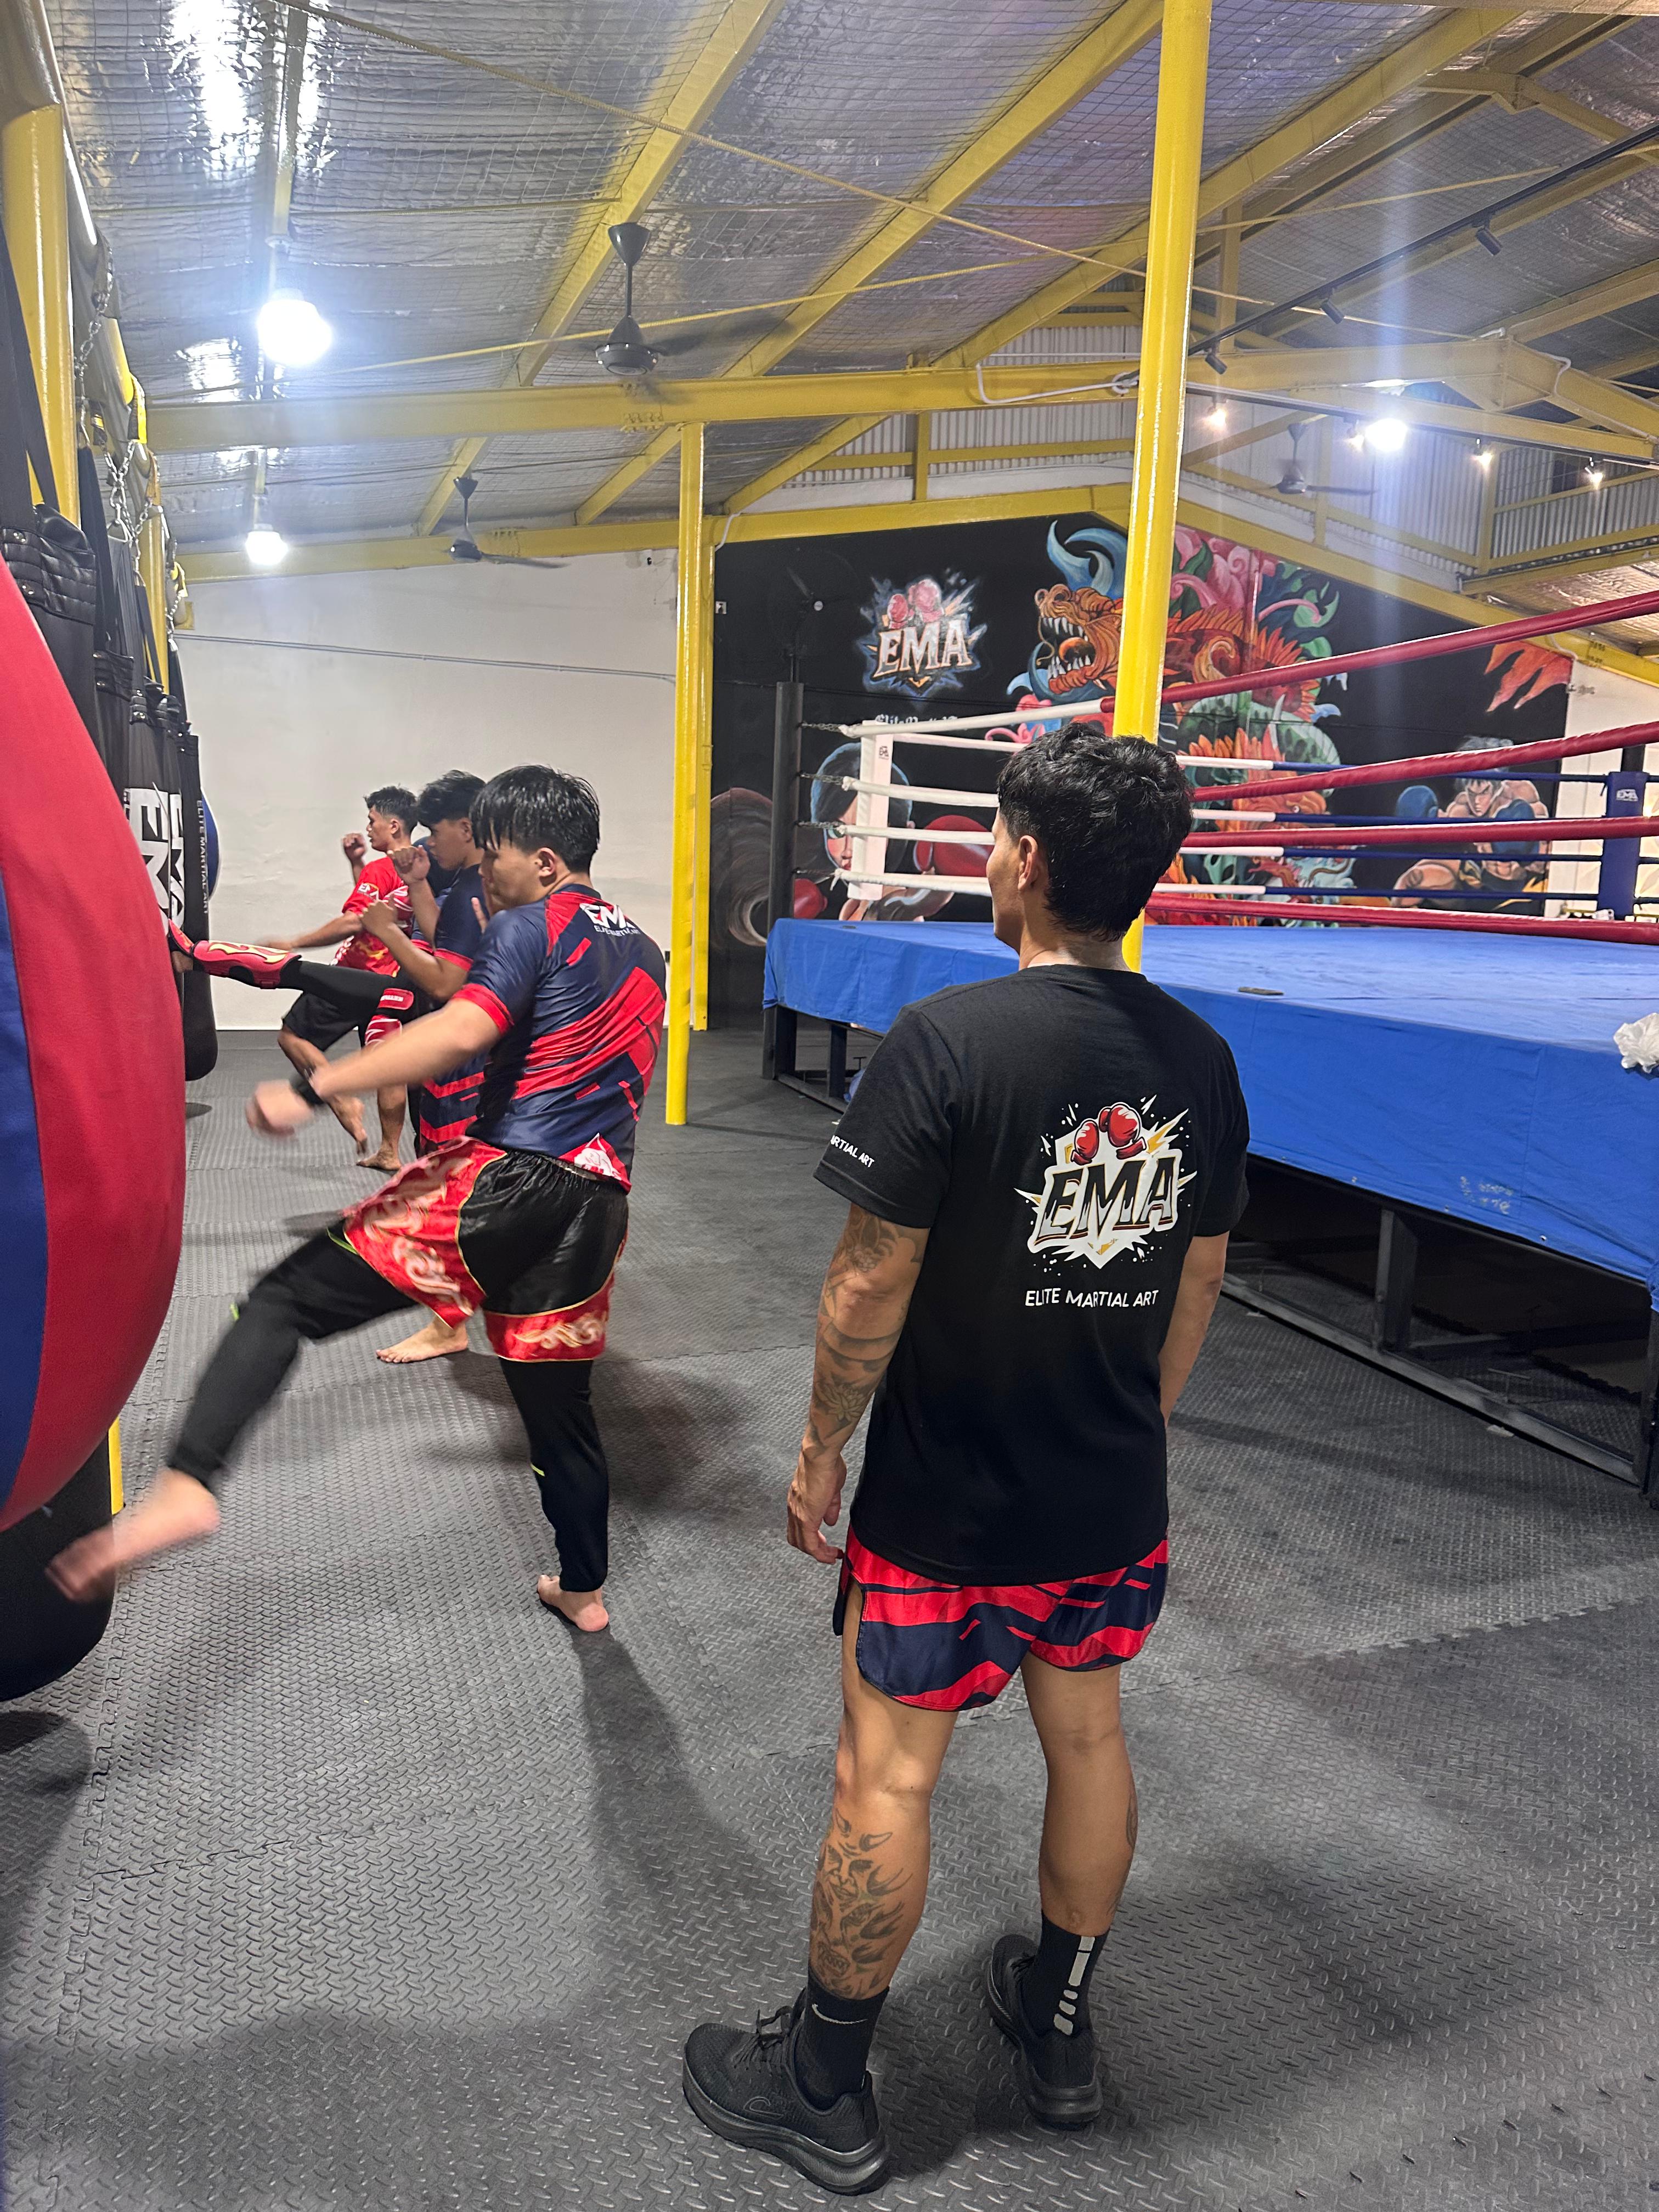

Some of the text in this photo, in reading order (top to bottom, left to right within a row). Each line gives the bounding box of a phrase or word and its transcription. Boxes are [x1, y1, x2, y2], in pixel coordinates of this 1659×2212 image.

[872, 617, 973, 678] EMA
[858, 1153, 875, 1167] ART
[1034, 1155, 1177, 1246] EMA
[1025, 1288, 1159, 1308] ELITE MARTIAL ART
